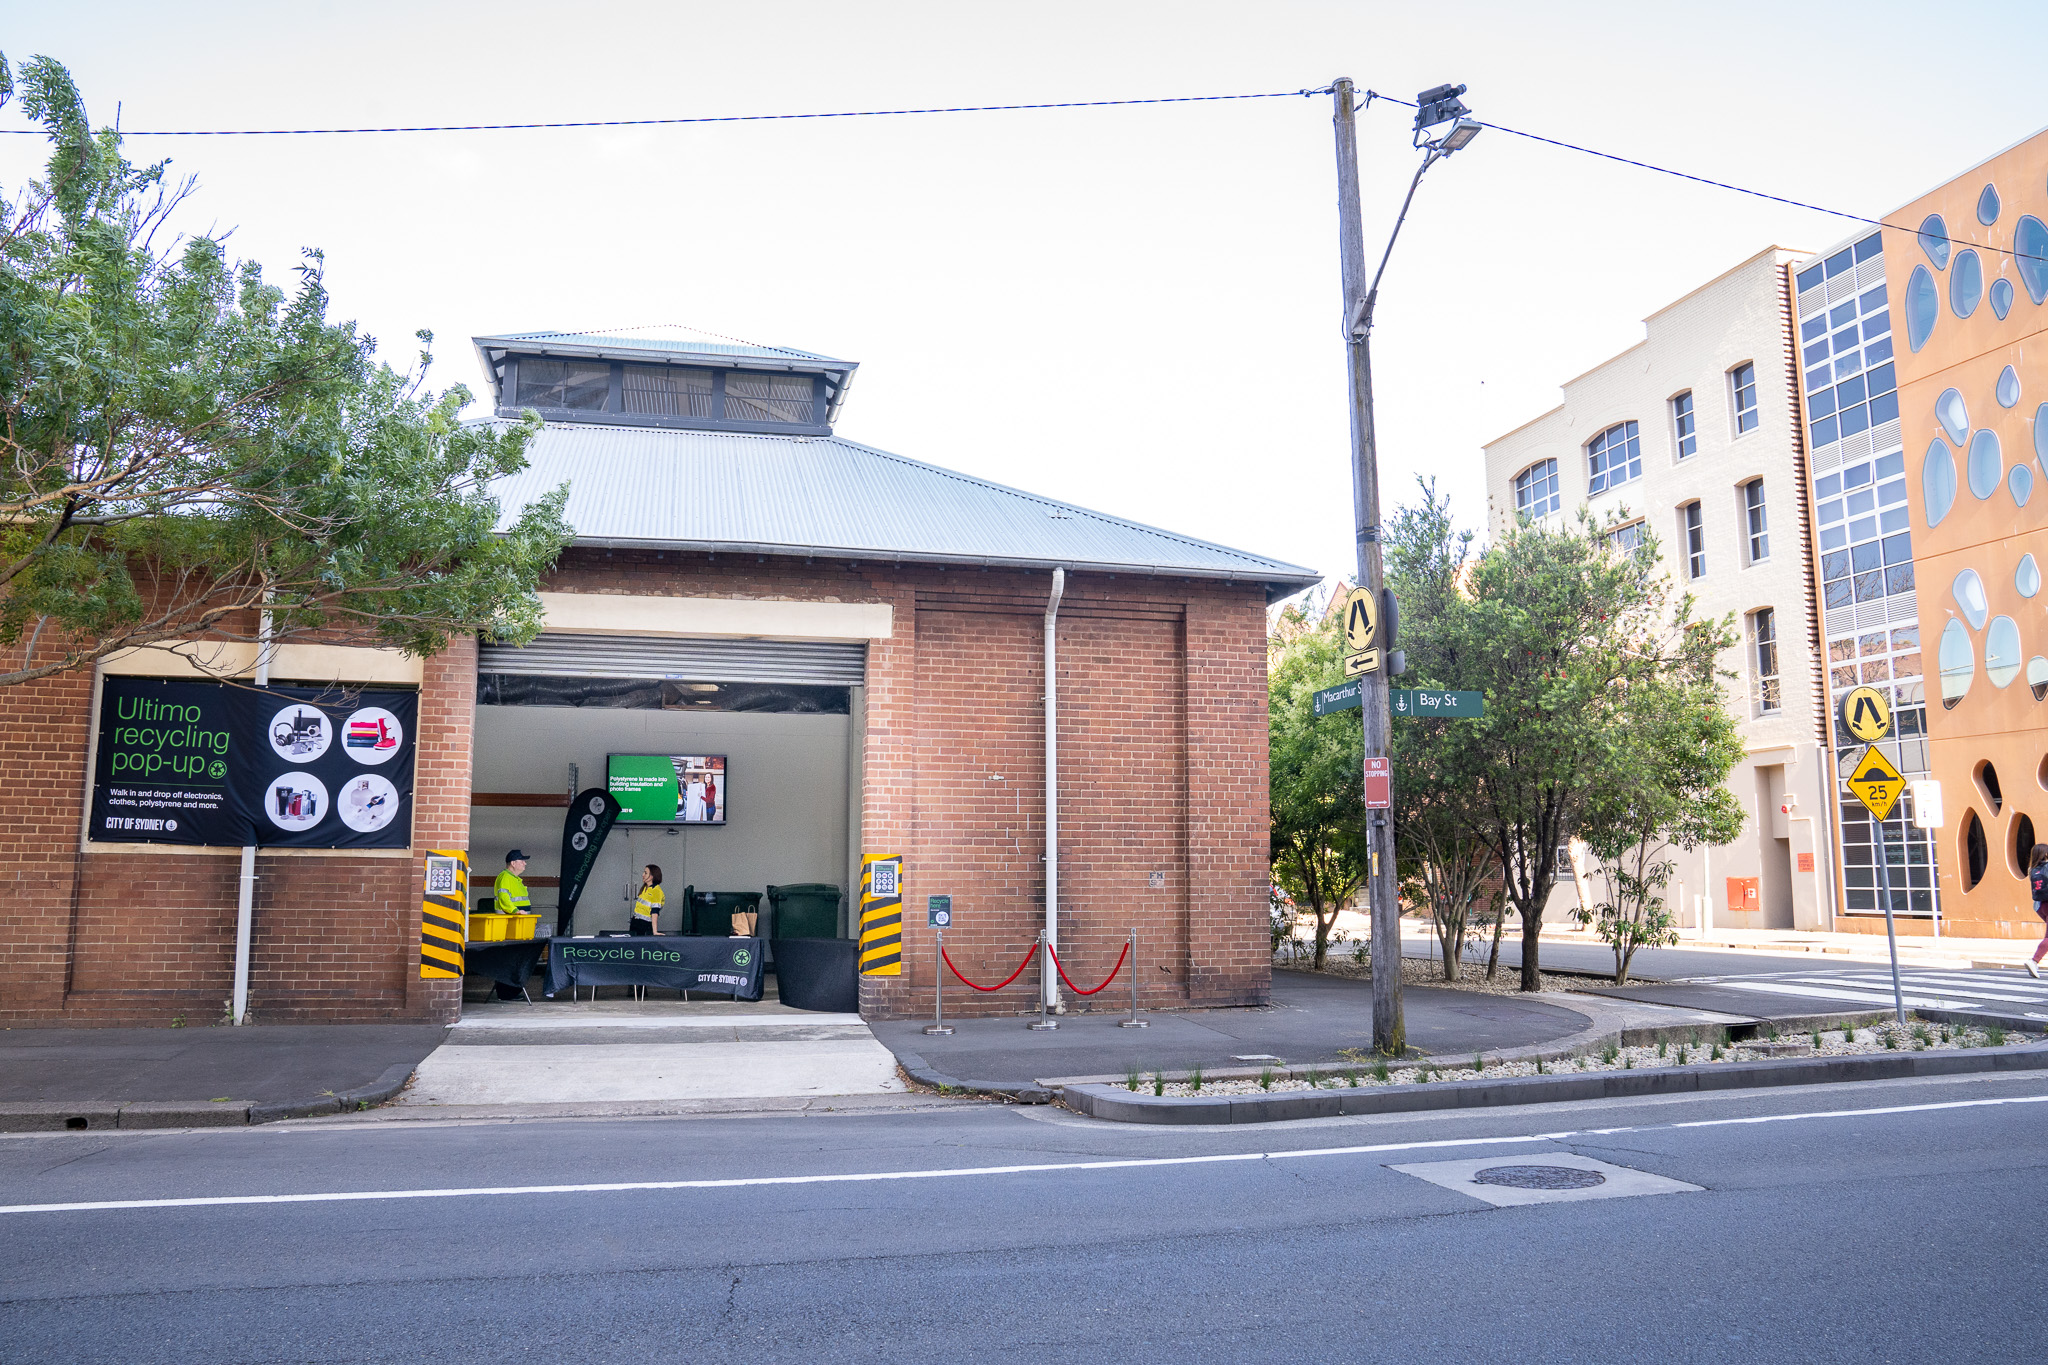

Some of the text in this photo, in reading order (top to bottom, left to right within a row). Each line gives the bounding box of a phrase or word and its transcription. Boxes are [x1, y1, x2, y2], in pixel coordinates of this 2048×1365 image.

[1323, 681, 1362, 703] Macarthur S
[1420, 693, 1457, 709] Bay St
[118, 696, 201, 723] Ultimo
[114, 724, 230, 755] recycling
[112, 752, 205, 779] pop-up
[1371, 760, 1381, 769] NO
[1365, 770, 1388, 778] STOPPING
[129, 789, 137, 797] in
[153, 790, 171, 799] drop
[172, 791, 182, 799] off
[183, 792, 224, 801] electronics,
[1868, 785, 1888, 800] 25
[109, 798, 138, 807] clothes,
[139, 799, 182, 808] polystyrene
[106, 817, 165, 831] CITY OF SYDNEY
[563, 946, 681, 962] Recycle here
[697, 974, 740, 985] CITY OF SYDNEY
